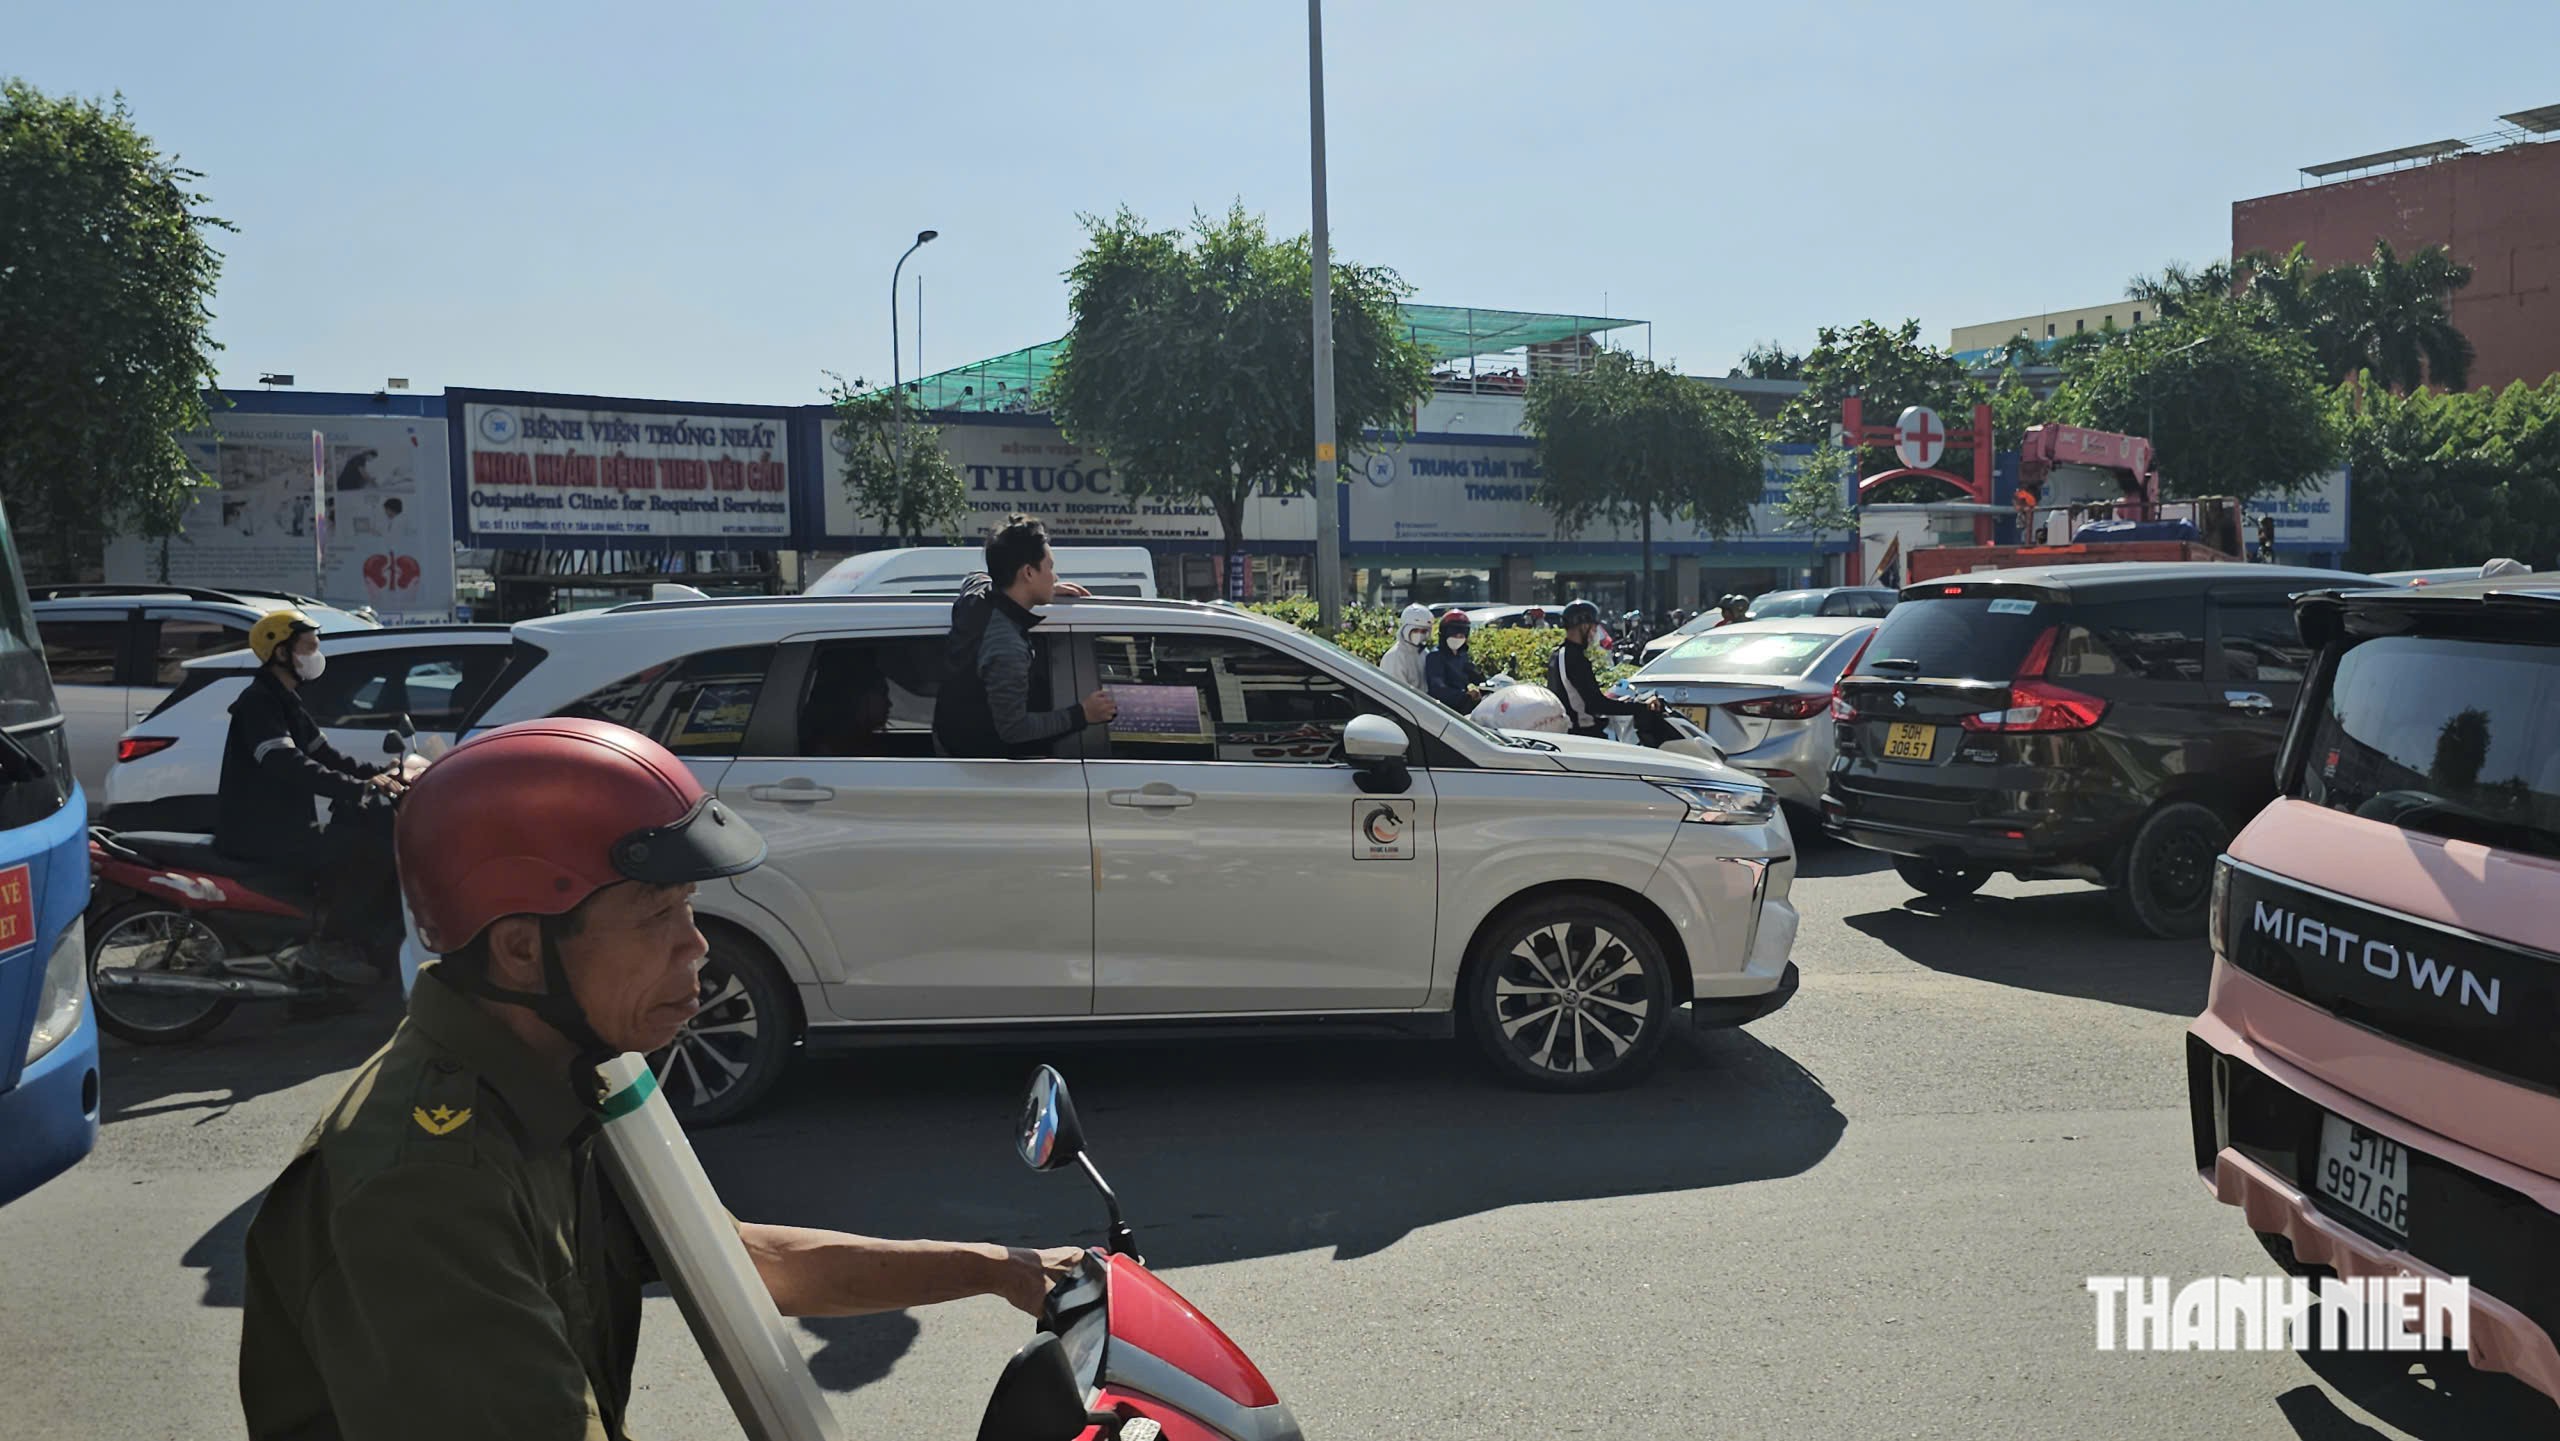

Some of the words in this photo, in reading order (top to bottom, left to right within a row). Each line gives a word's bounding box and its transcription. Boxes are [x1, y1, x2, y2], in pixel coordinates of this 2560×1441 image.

[522, 413, 584, 445] BỆNH
[588, 417, 641, 448] VIỆN
[645, 418, 716, 447] THỐNG
[720, 422, 776, 448] NHẤT
[473, 451, 533, 486] KHOA
[535, 447, 597, 487] KHÁM
[601, 450, 656, 494] BỆNH
[658, 457, 707, 491] THEO
[708, 454, 745, 491] YÊU
[966, 459, 1111, 494] THUỐC
[1409, 458, 1469, 478] TRUNG
[1472, 456, 1508, 479] TÂM
[471, 490, 563, 512] Outpatient
[568, 492, 619, 510] Clinic
[622, 494, 646, 511] for
[649, 495, 719, 515] Required
[723, 497, 785, 513] Services
[1464, 483, 1520, 501] THONG
[968, 501, 1012, 513] HONG
[1017, 502, 1061, 514] NHAT
[1065, 503, 1137, 516] HOSPITAL
[1142, 504, 1217, 516] PHARMAC
[1901, 724, 1922, 740] 50H
[1889, 739, 1928, 758] 308.57
[1, 876, 22, 905] VÉ
[2253, 900, 2500, 1016] MIATOWN
[2349, 1123, 2397, 1180] 51H
[2326, 1157, 2408, 1233] 997.68
